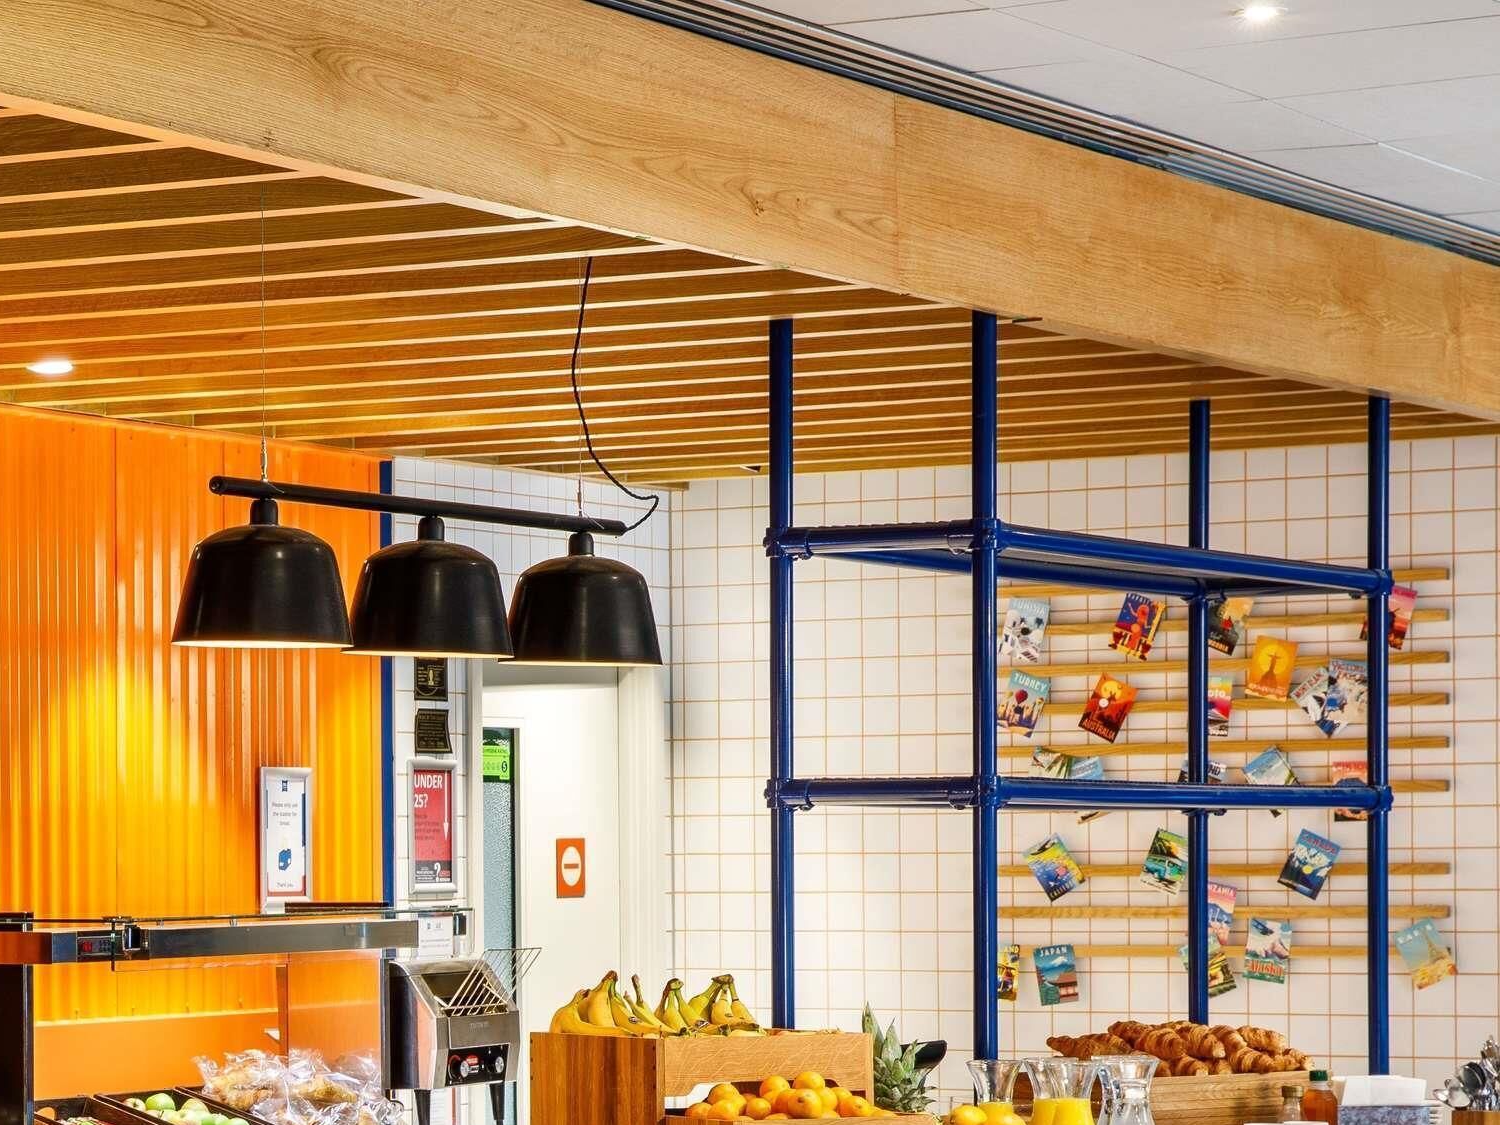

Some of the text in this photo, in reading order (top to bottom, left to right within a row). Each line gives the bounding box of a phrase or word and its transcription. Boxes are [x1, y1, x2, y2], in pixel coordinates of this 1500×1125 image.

[1013, 672, 1048, 692] TURKEY
[1207, 689, 1226, 698] oto
[1083, 718, 1116, 740] AUSTRALIA
[414, 774, 442, 789] UNDER
[414, 793, 429, 808] 25?
[1208, 882, 1234, 896] NZANIA
[1002, 945, 1019, 954] AND
[1041, 946, 1067, 958] JAPAN
